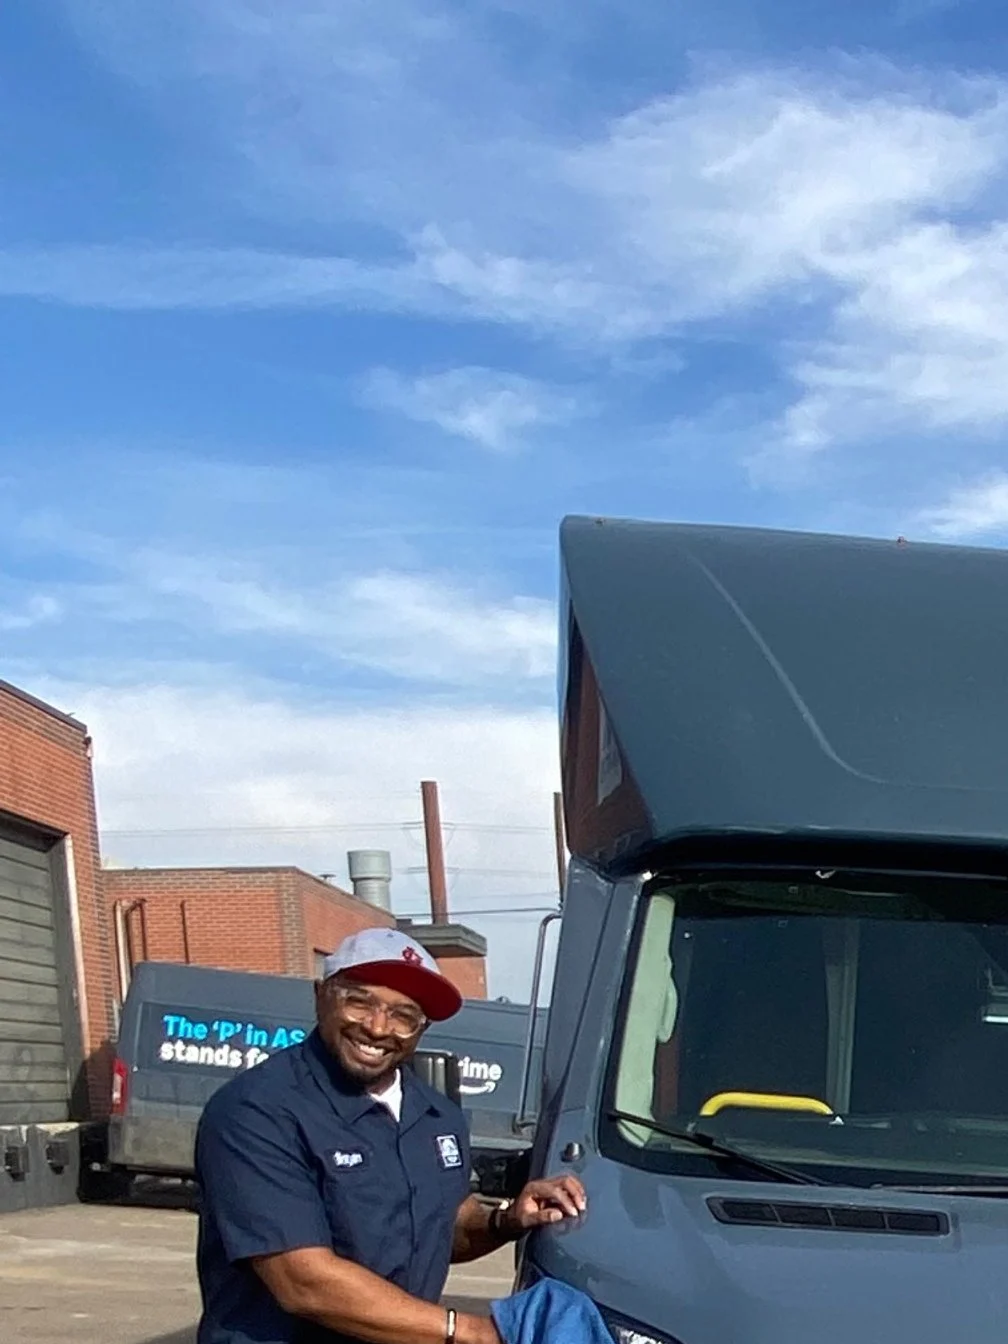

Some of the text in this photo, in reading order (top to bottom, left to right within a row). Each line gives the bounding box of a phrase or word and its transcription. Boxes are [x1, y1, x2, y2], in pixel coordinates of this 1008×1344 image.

[163, 1014, 208, 1040] The
[245, 1023, 268, 1046] in
[160, 1039, 243, 1068] stands
